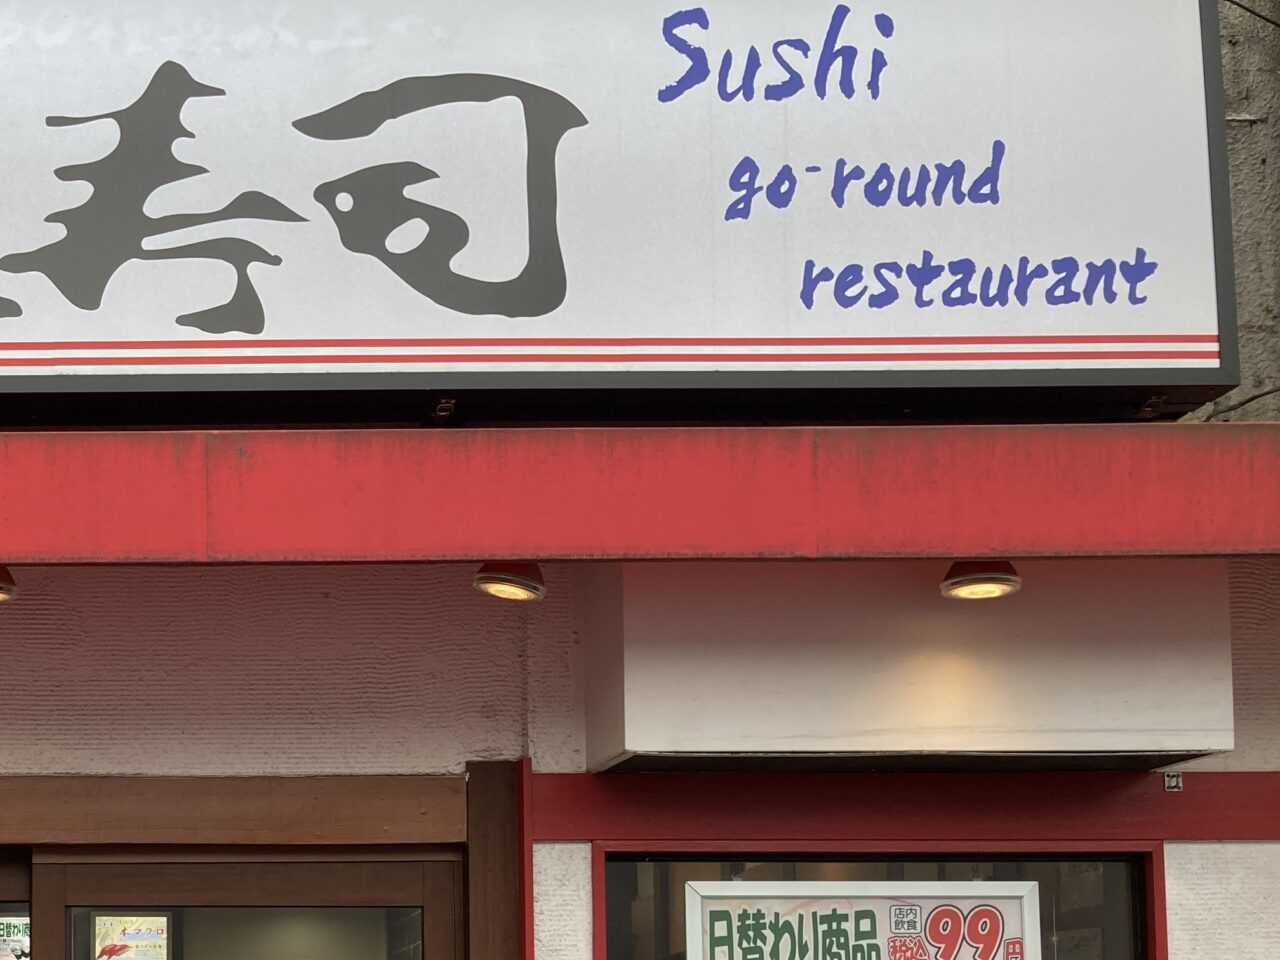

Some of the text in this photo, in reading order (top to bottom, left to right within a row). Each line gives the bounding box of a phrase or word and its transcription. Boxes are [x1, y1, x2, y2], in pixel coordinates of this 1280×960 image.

[658, 3, 895, 104] Sushi
[724, 139, 1006, 222] go-round
[800, 246, 1158, 310] restaurant
[893, 908, 918, 919] 店内
[894, 919, 918, 931] 飲食
